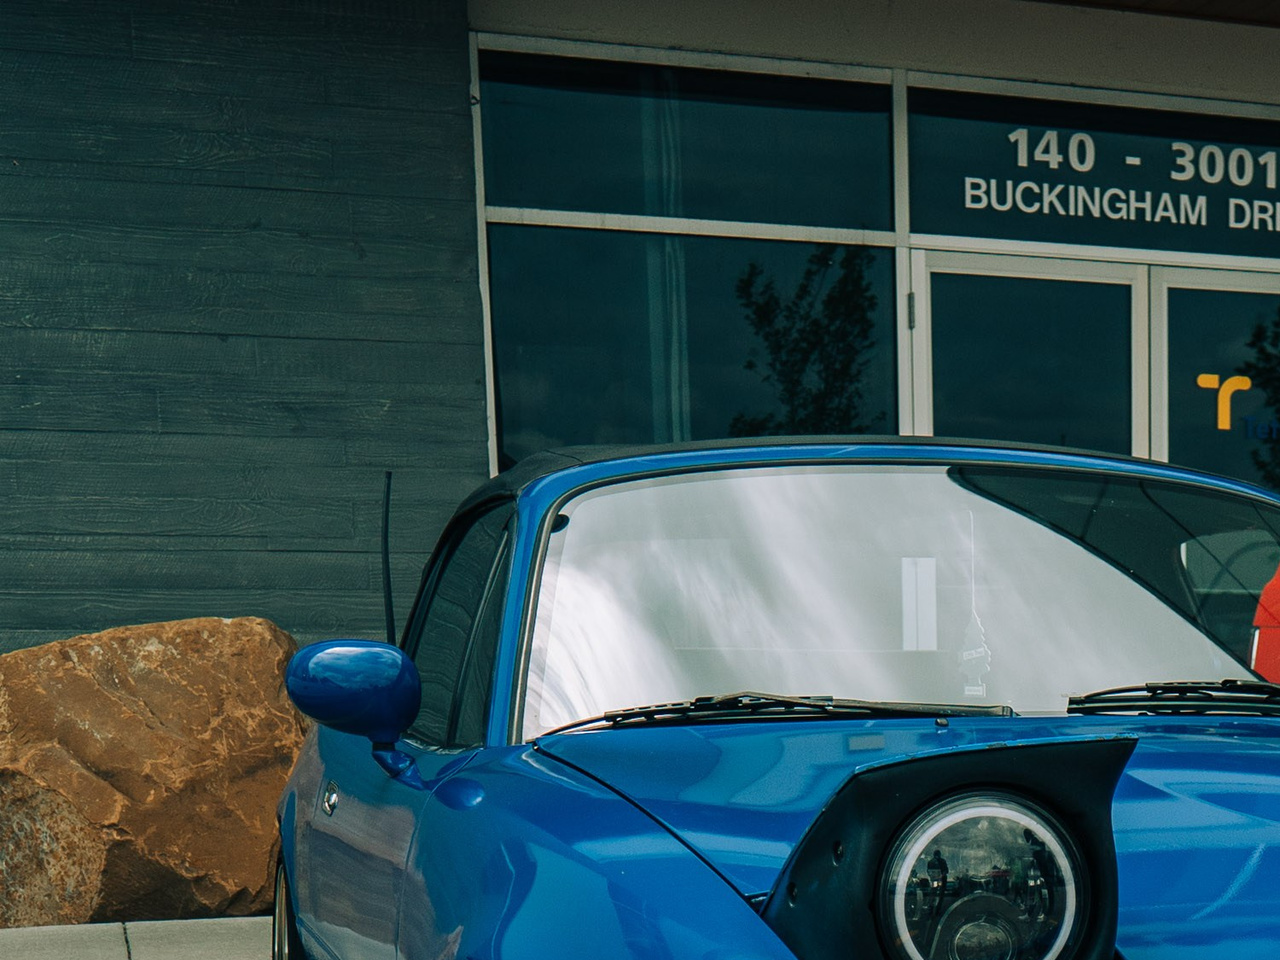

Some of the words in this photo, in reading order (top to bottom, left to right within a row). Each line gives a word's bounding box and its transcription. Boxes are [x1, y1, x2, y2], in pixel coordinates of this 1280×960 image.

[1007, 127, 1096, 173] 140
[1125, 155, 1142, 166] -
[1170, 141, 1278, 189] 3001
[964, 176, 1208, 227] BUCKINGHAM
